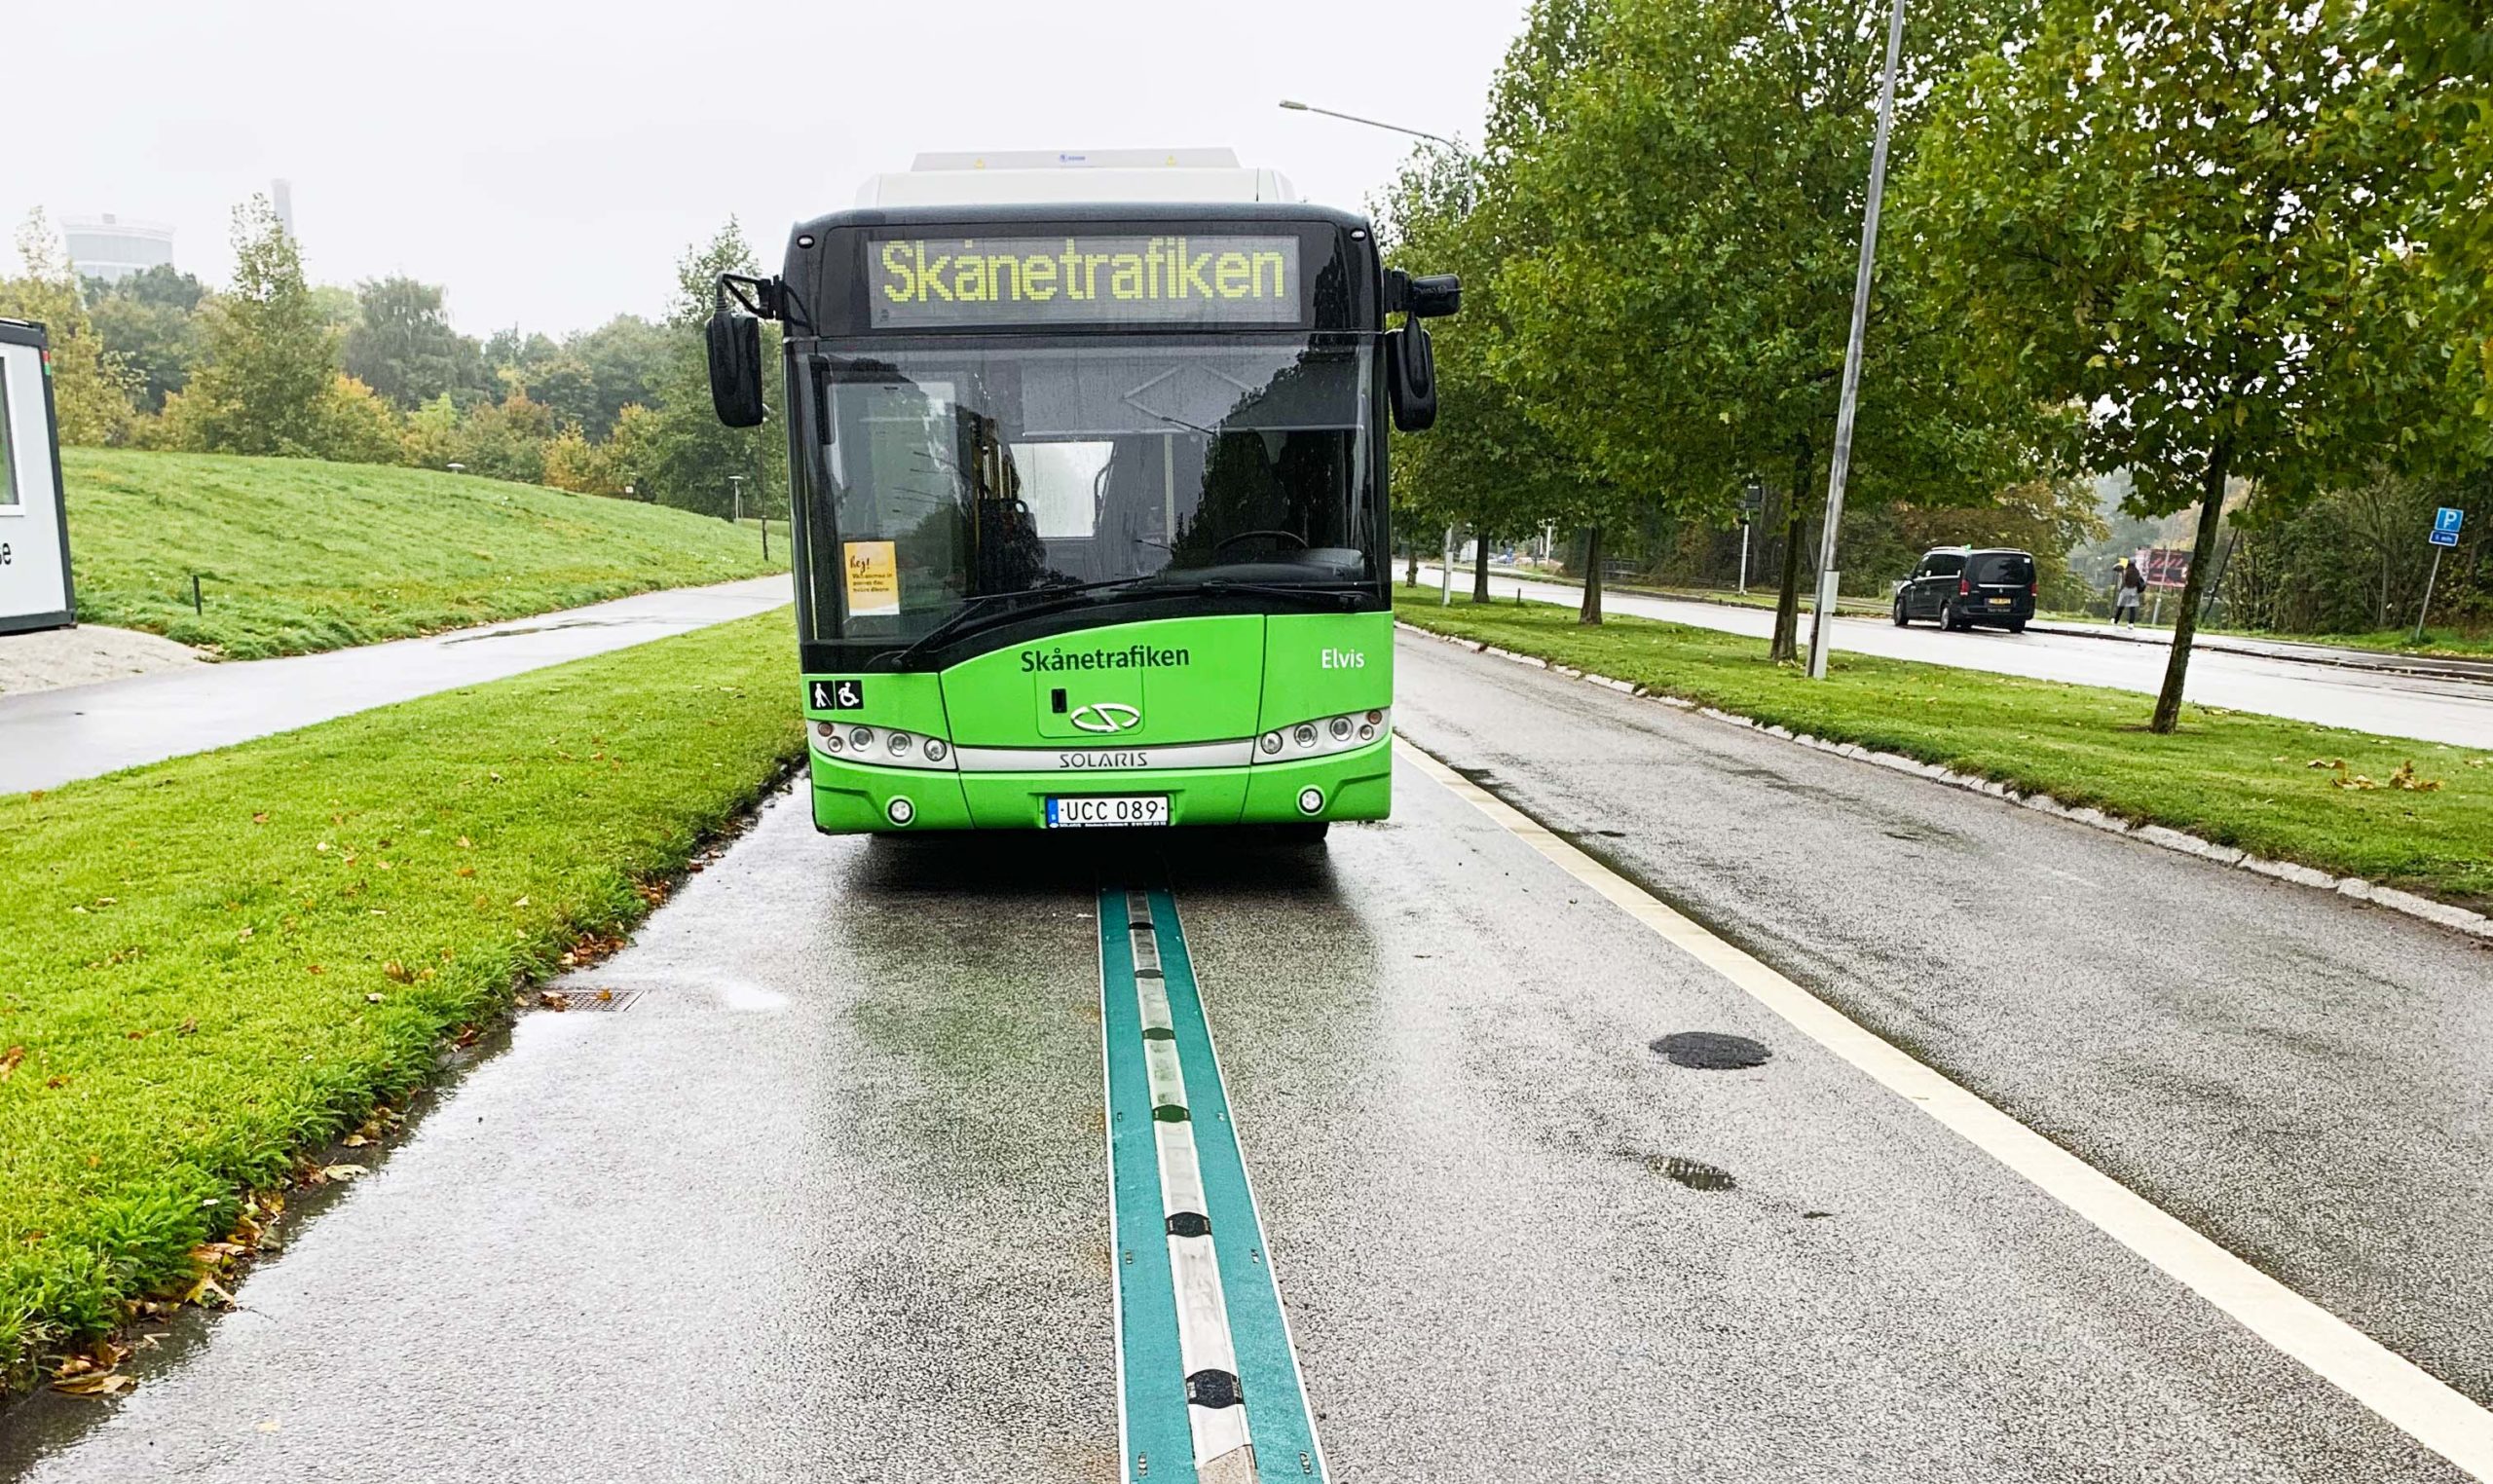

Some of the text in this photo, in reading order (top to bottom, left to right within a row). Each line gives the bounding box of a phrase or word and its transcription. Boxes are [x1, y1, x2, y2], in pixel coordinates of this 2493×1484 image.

[883, 238, 1284, 302] Skånetrafiken
[2443, 511, 2457, 529] P
[1022, 645, 1189, 672] Skånetrafiken
[1321, 648, 1364, 669] Elvis
[1060, 752, 1147, 768] SOLARIS
[1067, 800, 1158, 821] UCC 089
